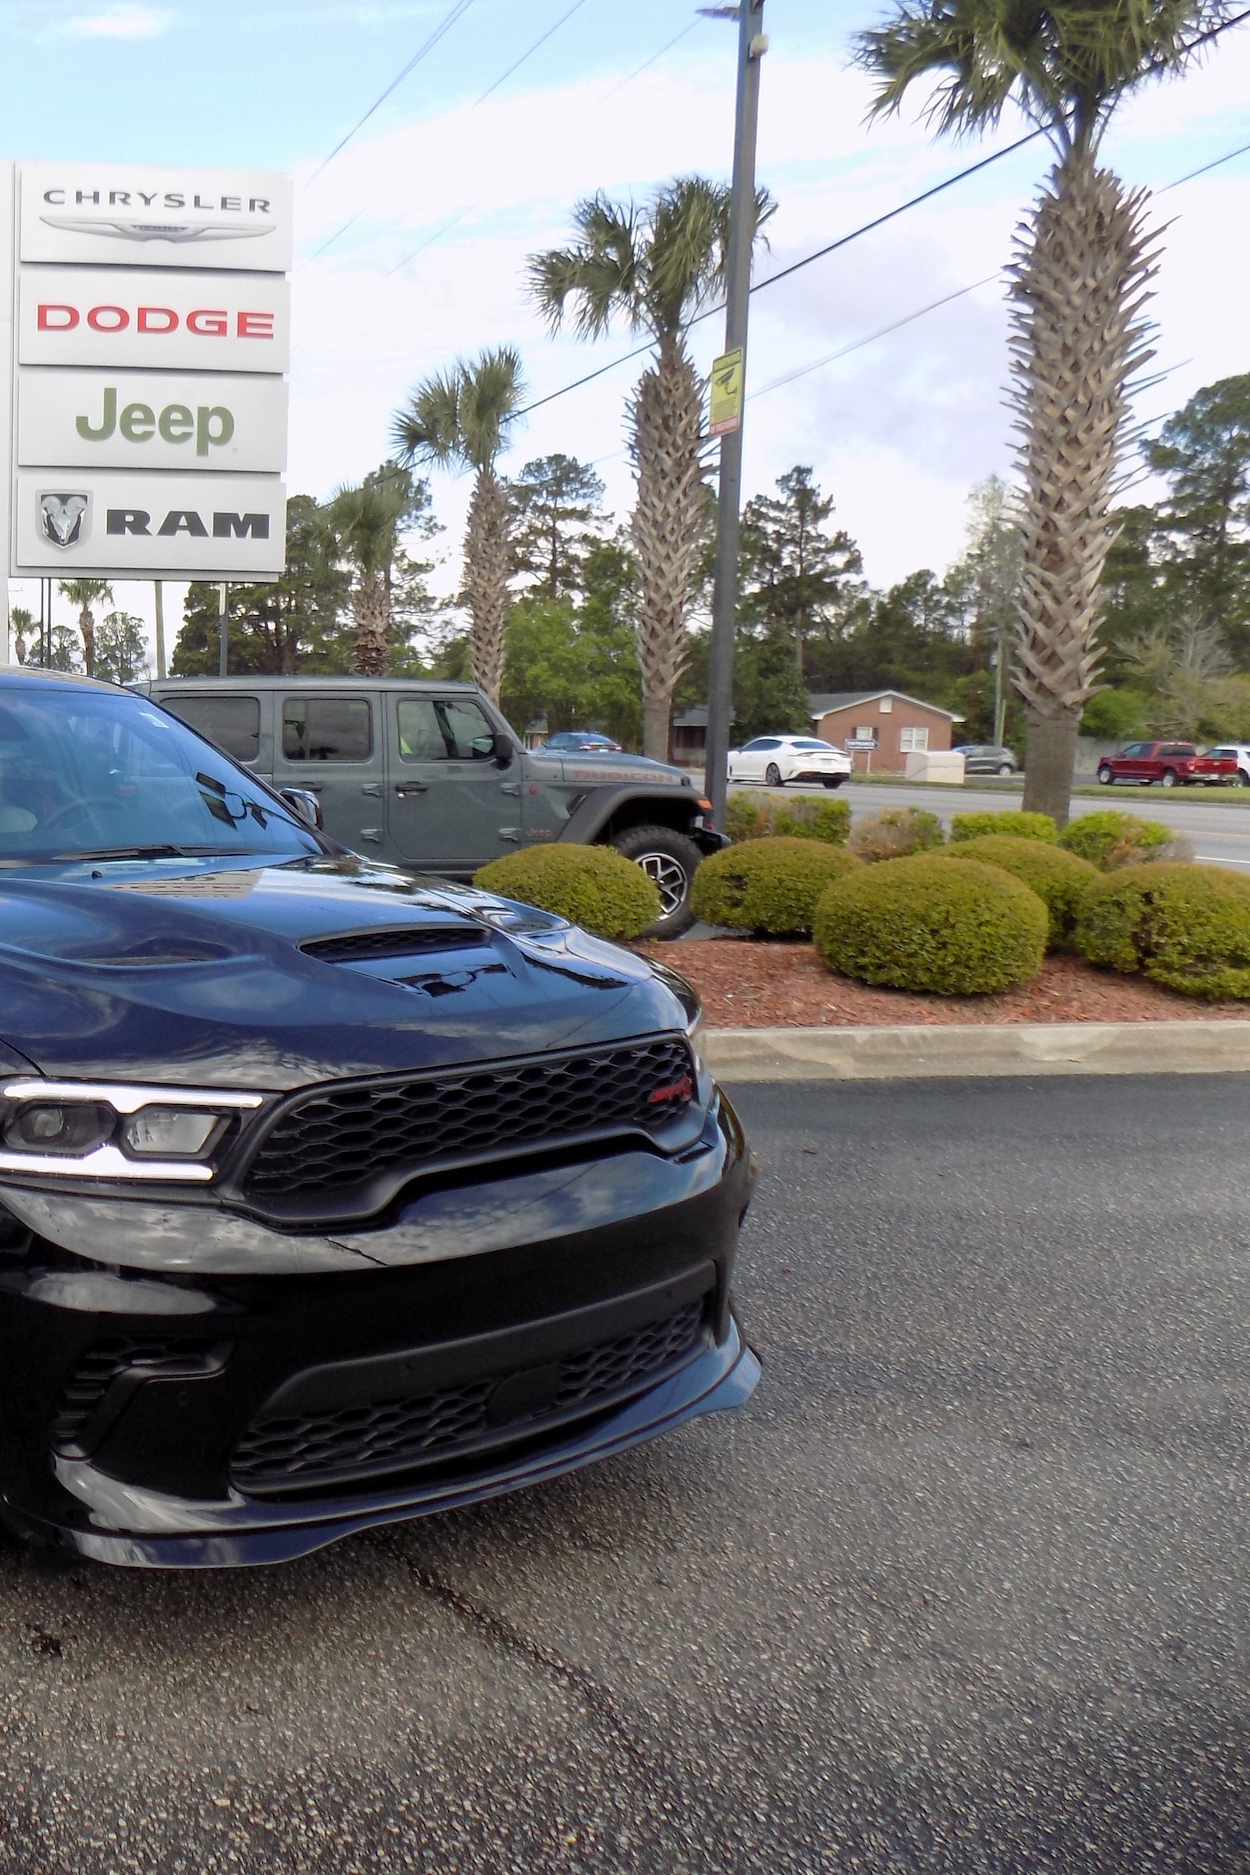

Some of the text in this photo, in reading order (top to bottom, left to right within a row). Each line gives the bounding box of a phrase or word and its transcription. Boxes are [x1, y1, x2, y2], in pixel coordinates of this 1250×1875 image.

[43, 189, 271, 213] CHRYSLER
[37, 304, 275, 340] DODGE
[75, 387, 235, 456] Jeep
[106, 509, 270, 539] RAM
[573, 770, 674, 783] RUBICON
